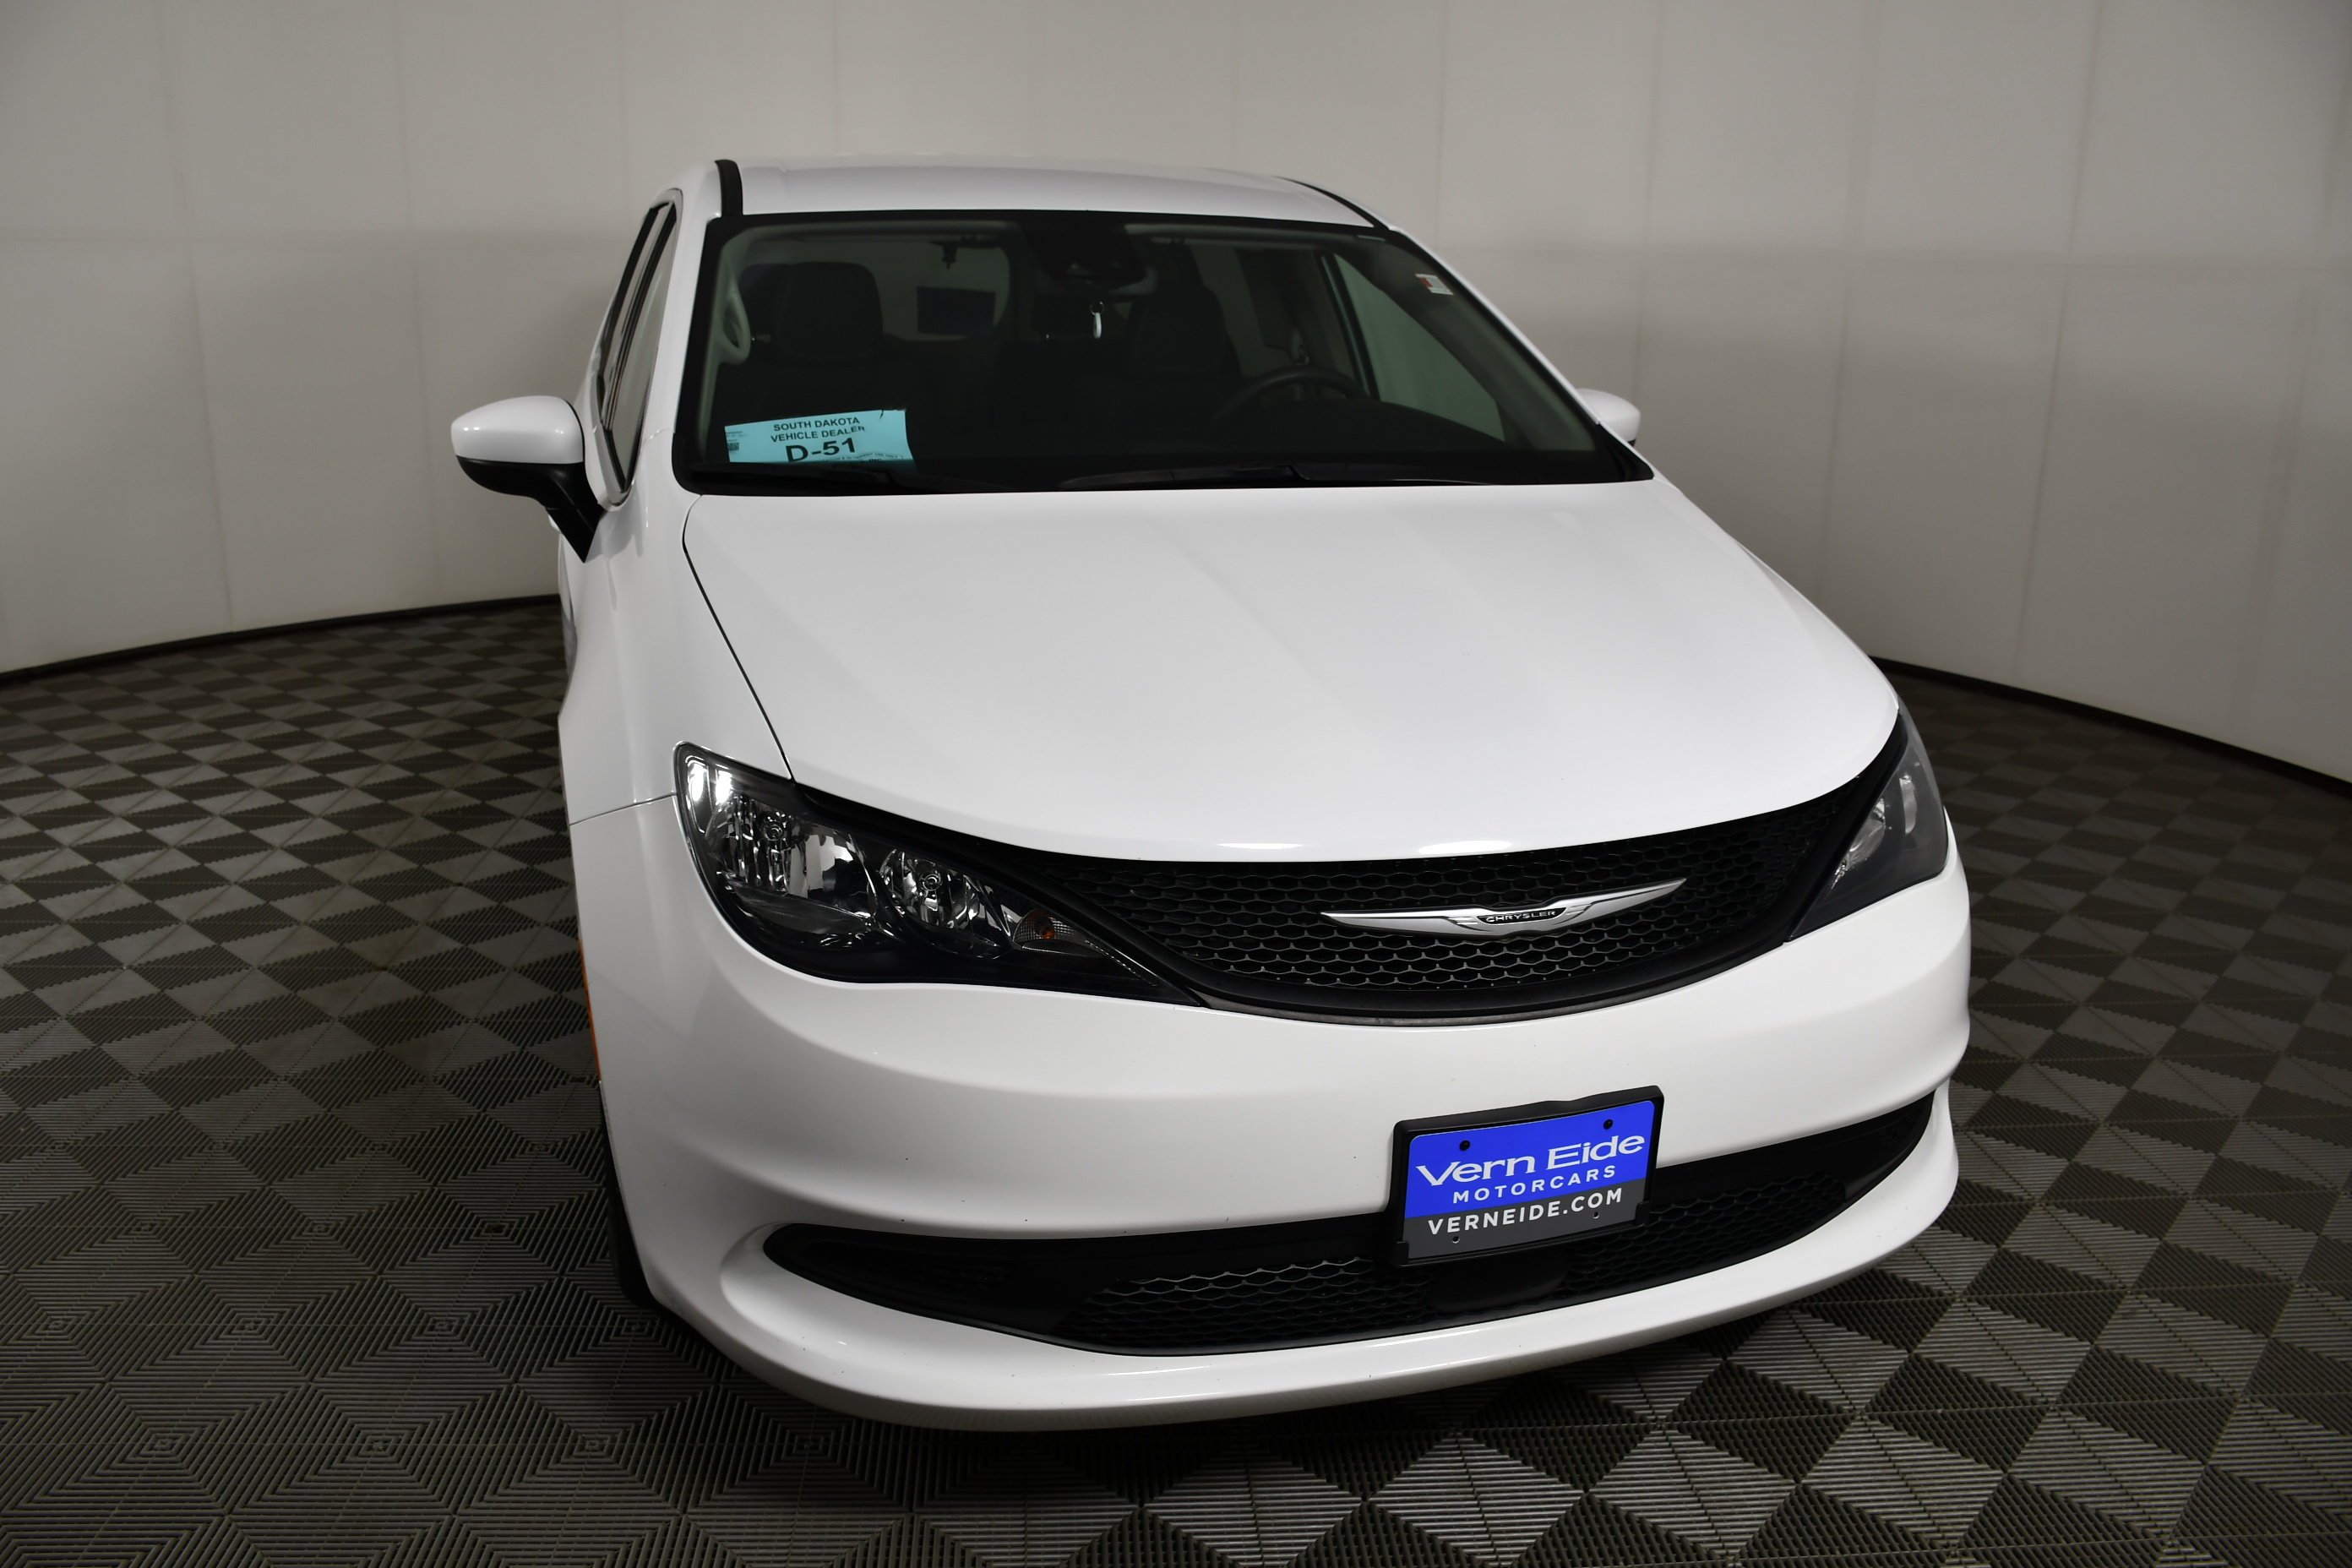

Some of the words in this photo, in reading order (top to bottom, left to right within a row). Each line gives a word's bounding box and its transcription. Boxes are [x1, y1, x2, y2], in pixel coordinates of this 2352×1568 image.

[770, 429, 819, 443] VEHICLE
[821, 425, 866, 438] DEALER
[773, 420, 812, 432] SOUTH
[814, 416, 861, 427] DAKOTA
[785, 437, 857, 462] D-51
[1485, 911, 1556, 923] CHRYSLER
[1415, 1156, 1536, 1187] Vern
[1547, 1135, 1646, 1170] Eide
[1452, 1164, 1616, 1204] MOTORCARS
[1428, 1187, 1623, 1235] VERNEIDE.COM
